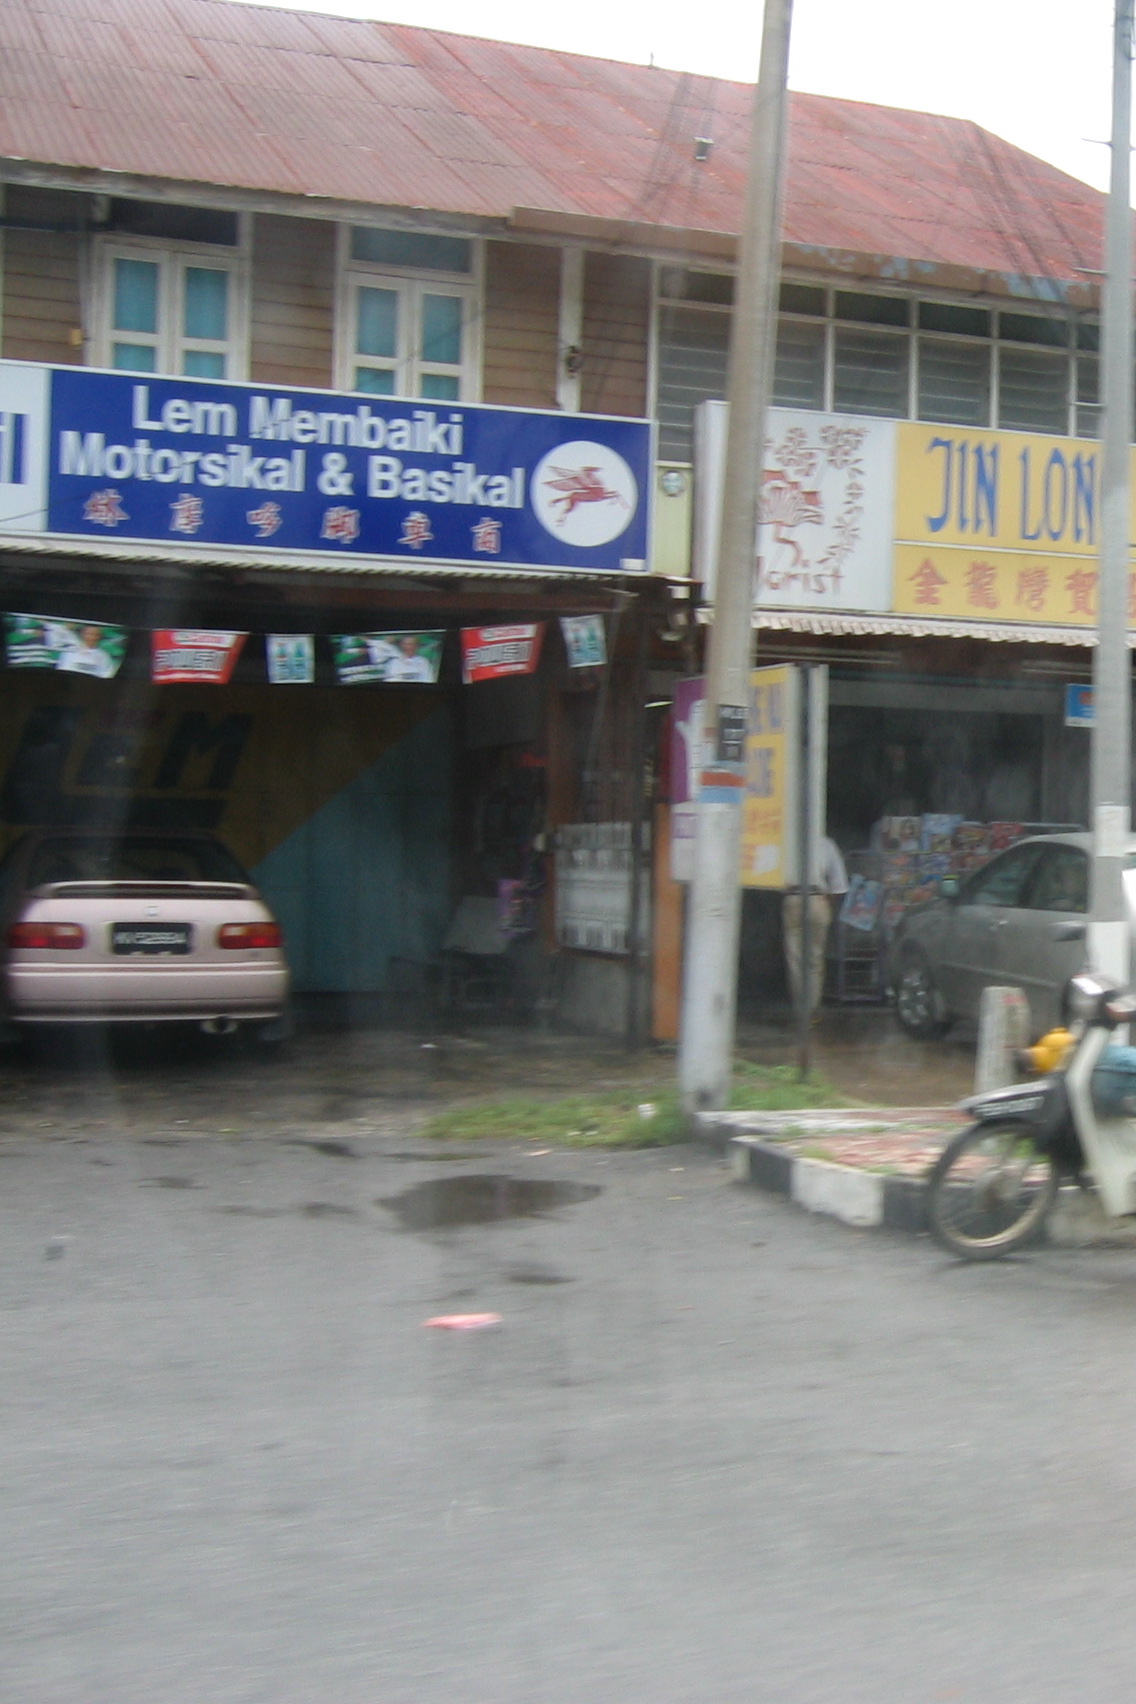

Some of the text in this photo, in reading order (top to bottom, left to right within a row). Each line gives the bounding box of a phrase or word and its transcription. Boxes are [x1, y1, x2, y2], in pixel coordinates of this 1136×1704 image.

[132, 384, 464, 456] Lem Membaiki
[58, 430, 306, 492] Motorsikal
[317, 451, 355, 496] &
[366, 455, 526, 509] Basikal
[926, 436, 998, 538] JIN
[1019, 445, 1097, 546] LON
[756, 555, 845, 595] lorist
